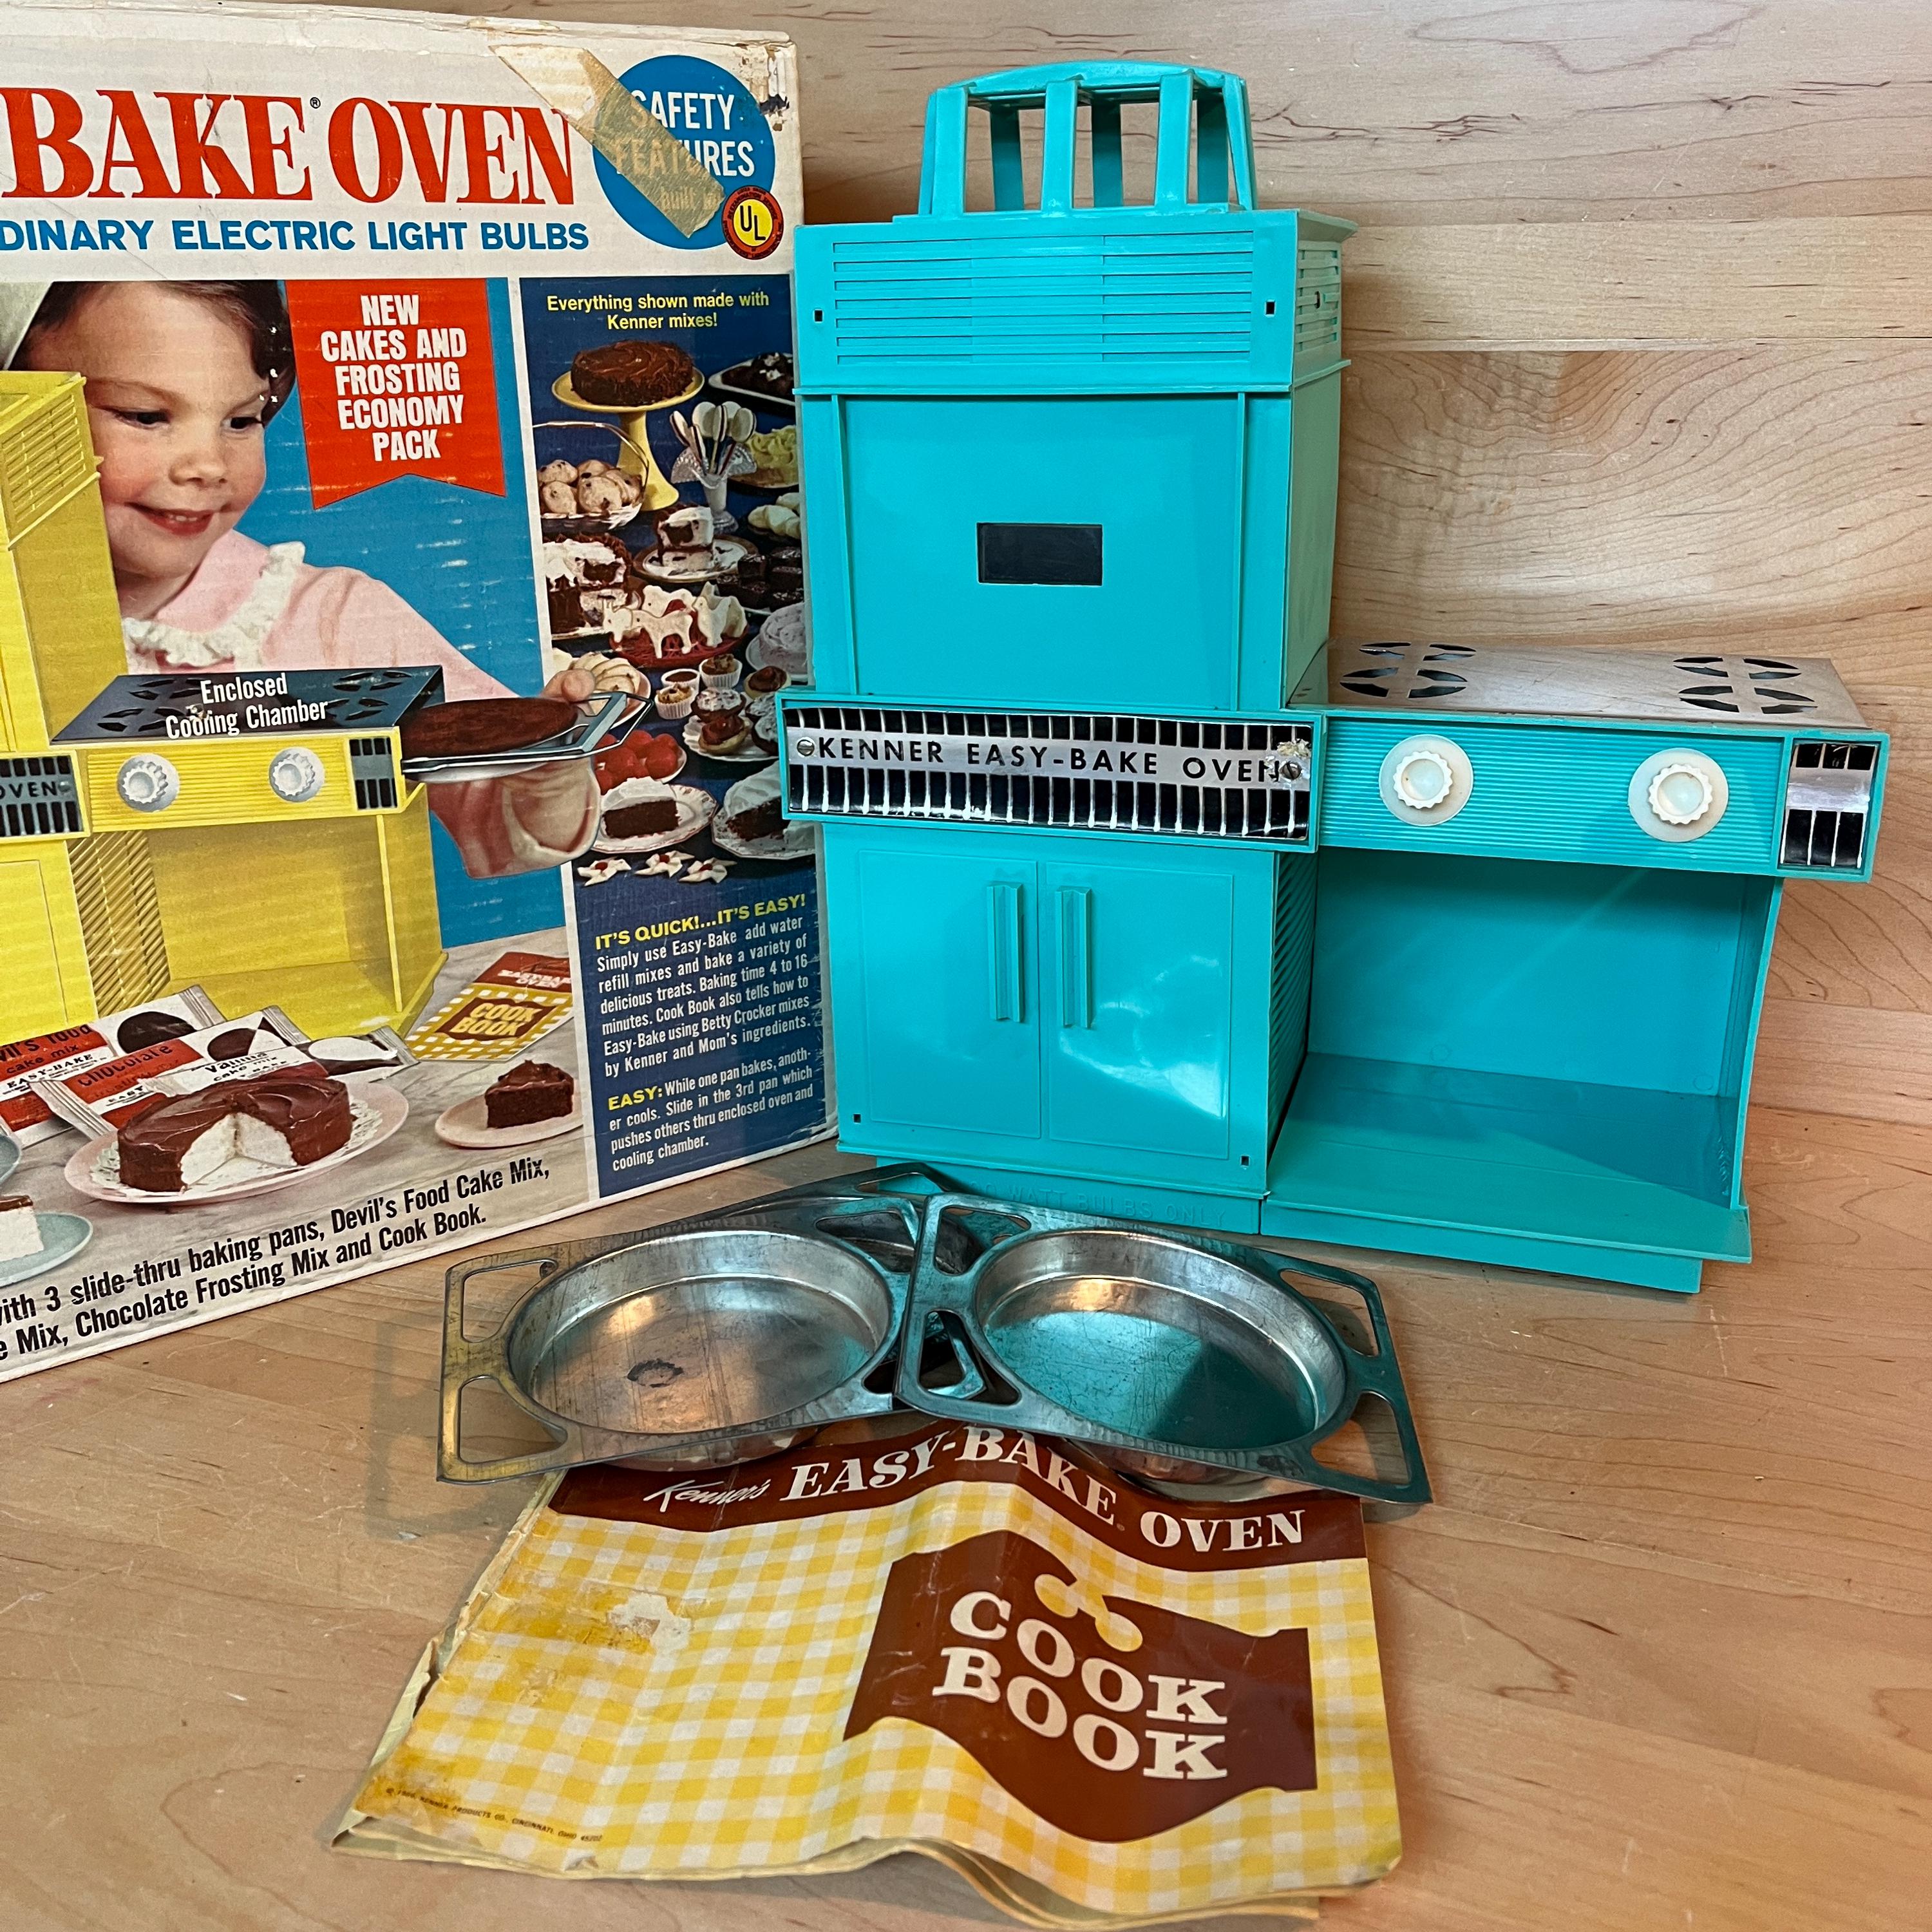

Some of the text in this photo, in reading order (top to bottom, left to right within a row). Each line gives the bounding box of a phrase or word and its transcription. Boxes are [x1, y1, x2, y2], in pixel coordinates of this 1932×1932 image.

[630, 90, 735, 131] SAFETY
[328, 97, 574, 204] OVEN
[172, 220, 355, 251] ELECTRIC
[368, 221, 468, 251] LIGHT
[480, 223, 589, 251] BULBS
[739, 205, 766, 241] UL
[360, 294, 419, 326] NEW
[547, 291, 770, 313] Everything shown made with
[607, 312, 717, 330] Kenner mixes!
[321, 327, 468, 362] CAKES AND
[334, 361, 460, 396] FROSTING
[337, 394, 464, 430] ECONOMY
[372, 428, 441, 462] PACK
[200, 672, 288, 705] Enclosed
[245, 699, 328, 729] Chamber
[819, 737, 1281, 784] KENNER EASY-BAKE OVEN
[595, 931, 630, 950] IT'S
[755, 894, 806, 916] EASY!
[597, 916, 802, 972] Simply use Easy-Bake add water
[599, 933, 808, 994] refill mixes and bake a variety of
[600, 954, 808, 1014] delicious treats. Baking time 4 to 16
[469, 1003, 543, 1022] COOK
[602, 974, 809, 1036] minutes. Cook Book also tells how to
[451, 1016, 525, 1036] BOOK
[603, 995, 810, 1056] Easy-Bake using Betty Crocker mixes
[6, 1056, 45, 1074] cake
[51, 1044, 79, 1059] mix
[605, 1016, 811, 1077] by Kenner and Mom's ingredients.
[6, 1053, 94, 1090] EASY-BAKE
[607, 1046, 811, 1110] EASY: While one pan bakes, anoth-
[609, 1065, 813, 1132] er cools. Slide in the 3rd pan which
[611, 1083, 813, 1155] pushes others thru enclosed oven and
[612, 1135, 710, 1172] cooling chamber.
[1077, 1194, 1153, 1218] BULBS
[1164, 1204, 1226, 1227] ONLY
[44, 1285, 61, 1312] 3
[71, 1258, 181, 1305] slide-thru
[189, 1235, 261, 1271] baking
[269, 1220, 325, 1256] pans,
[330, 1197, 398, 1234] Devil's
[404, 1180, 450, 1214] Food
[456, 1168, 504, 1199] Cake
[509, 1157, 550, 1184] Mix,
[15, 1323, 68, 1355] Mix,
[75, 1289, 188, 1337] Chocolate
[195, 1262, 286, 1303] Frosting
[291, 1246, 330, 1276] Mix
[336, 1232, 372, 1264] and
[379, 1218, 428, 1252] Cook
[434, 1204, 486, 1236] Book.
[643, 1425, 1306, 1553] Kenner's EASY-BAKE OVEN
[950, 1591, 1228, 1725] COOK
[932, 1647, 1228, 1781] BOOK
[451, 1805, 491, 1819] PRODUCTS
